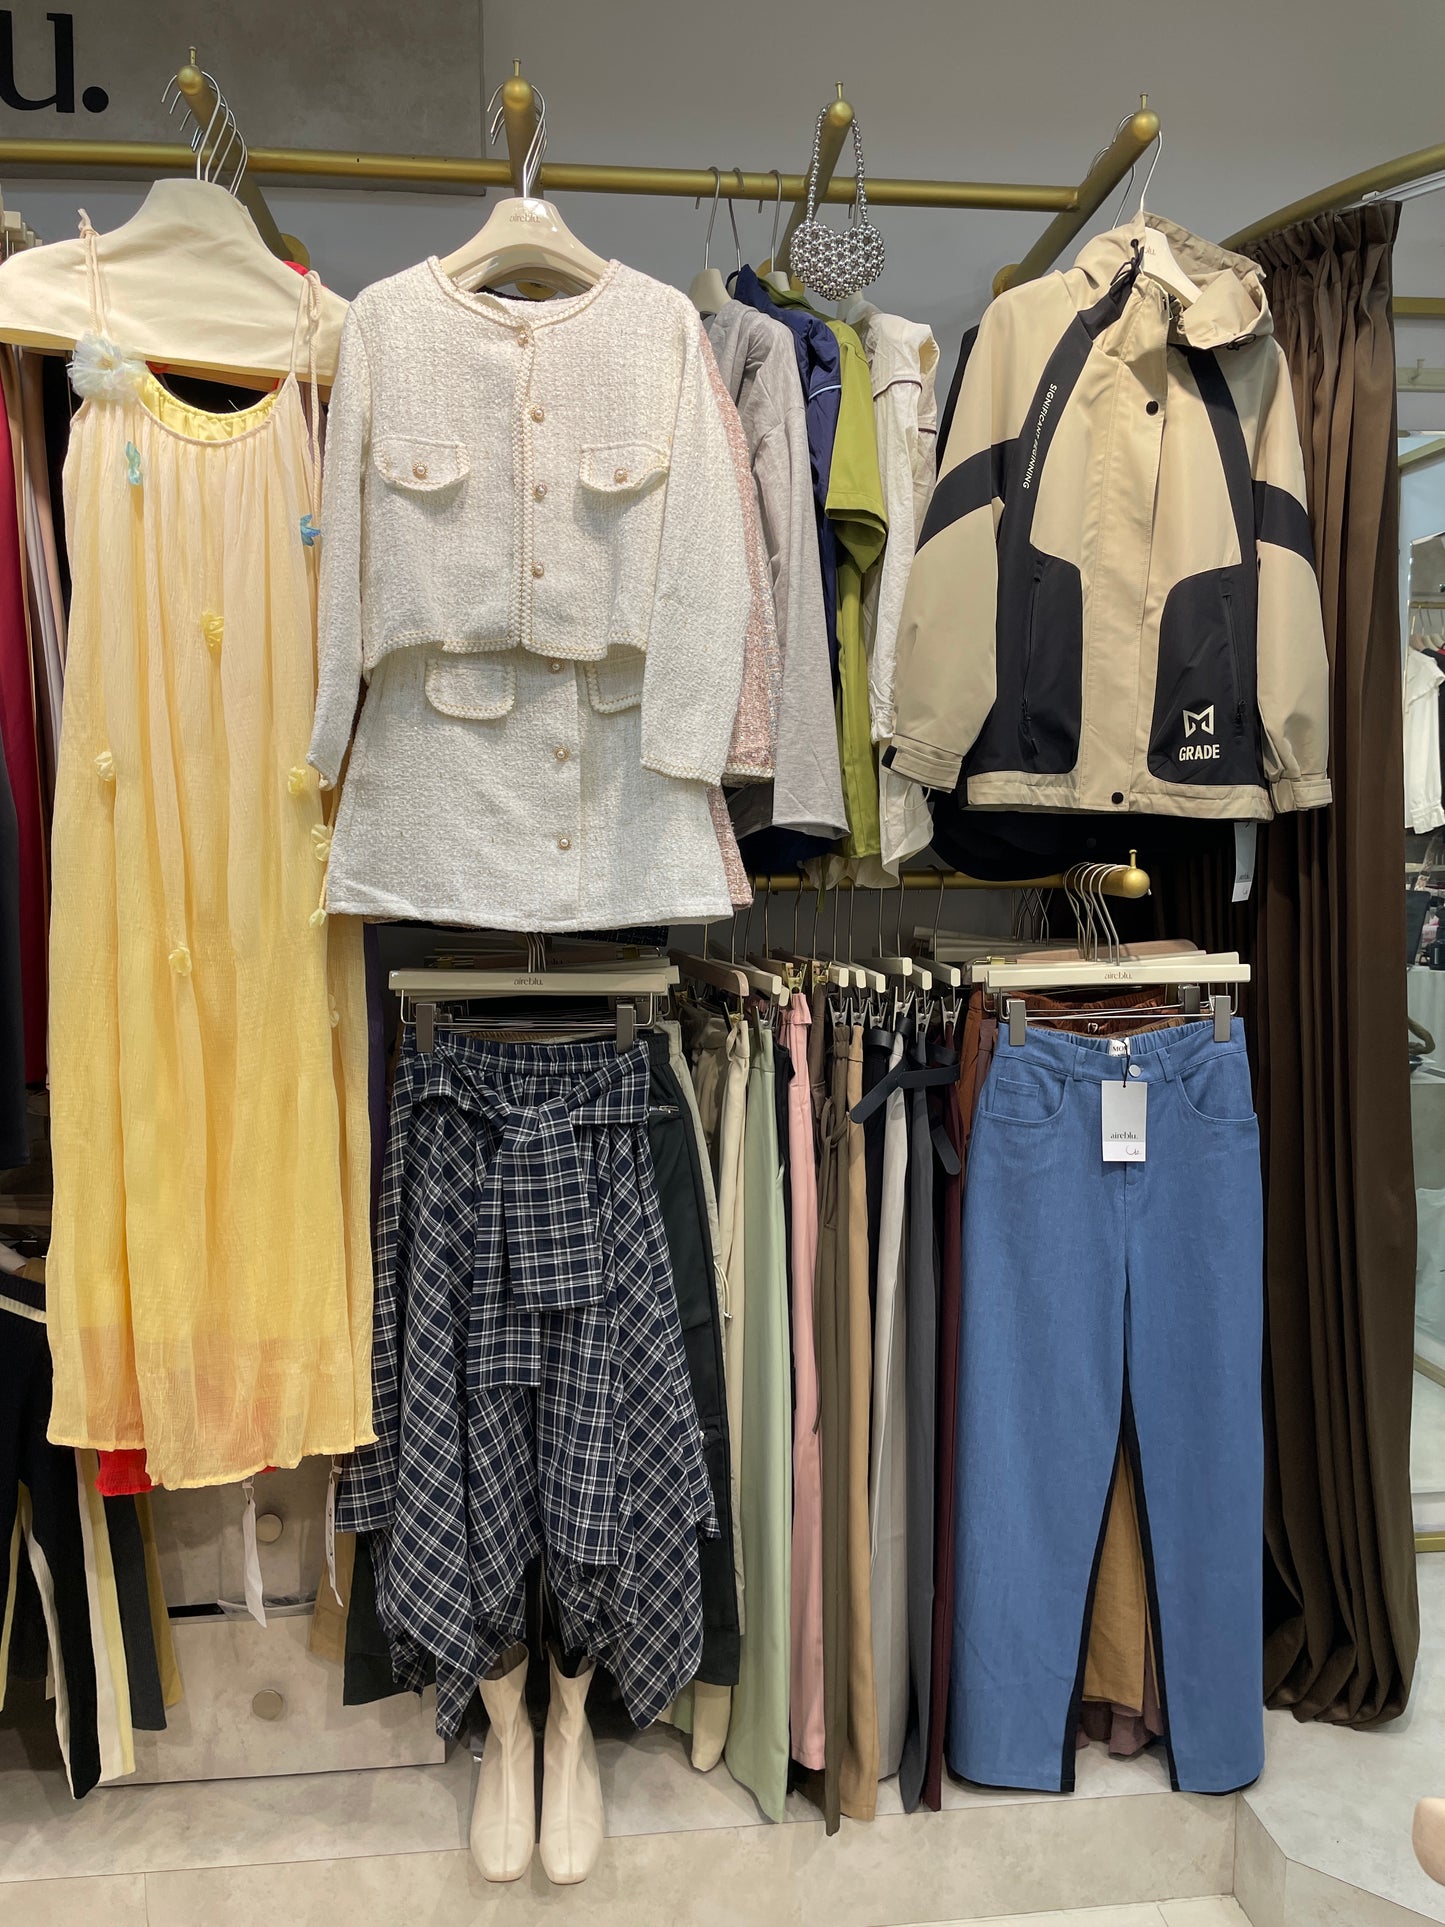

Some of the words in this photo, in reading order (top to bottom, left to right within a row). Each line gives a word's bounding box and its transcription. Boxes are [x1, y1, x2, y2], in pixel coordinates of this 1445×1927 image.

[1036, 383, 1058, 440] SIGNIFICANT
[1022, 439, 1039, 489] BEGINNING
[1179, 744, 1220, 762] GRADE
